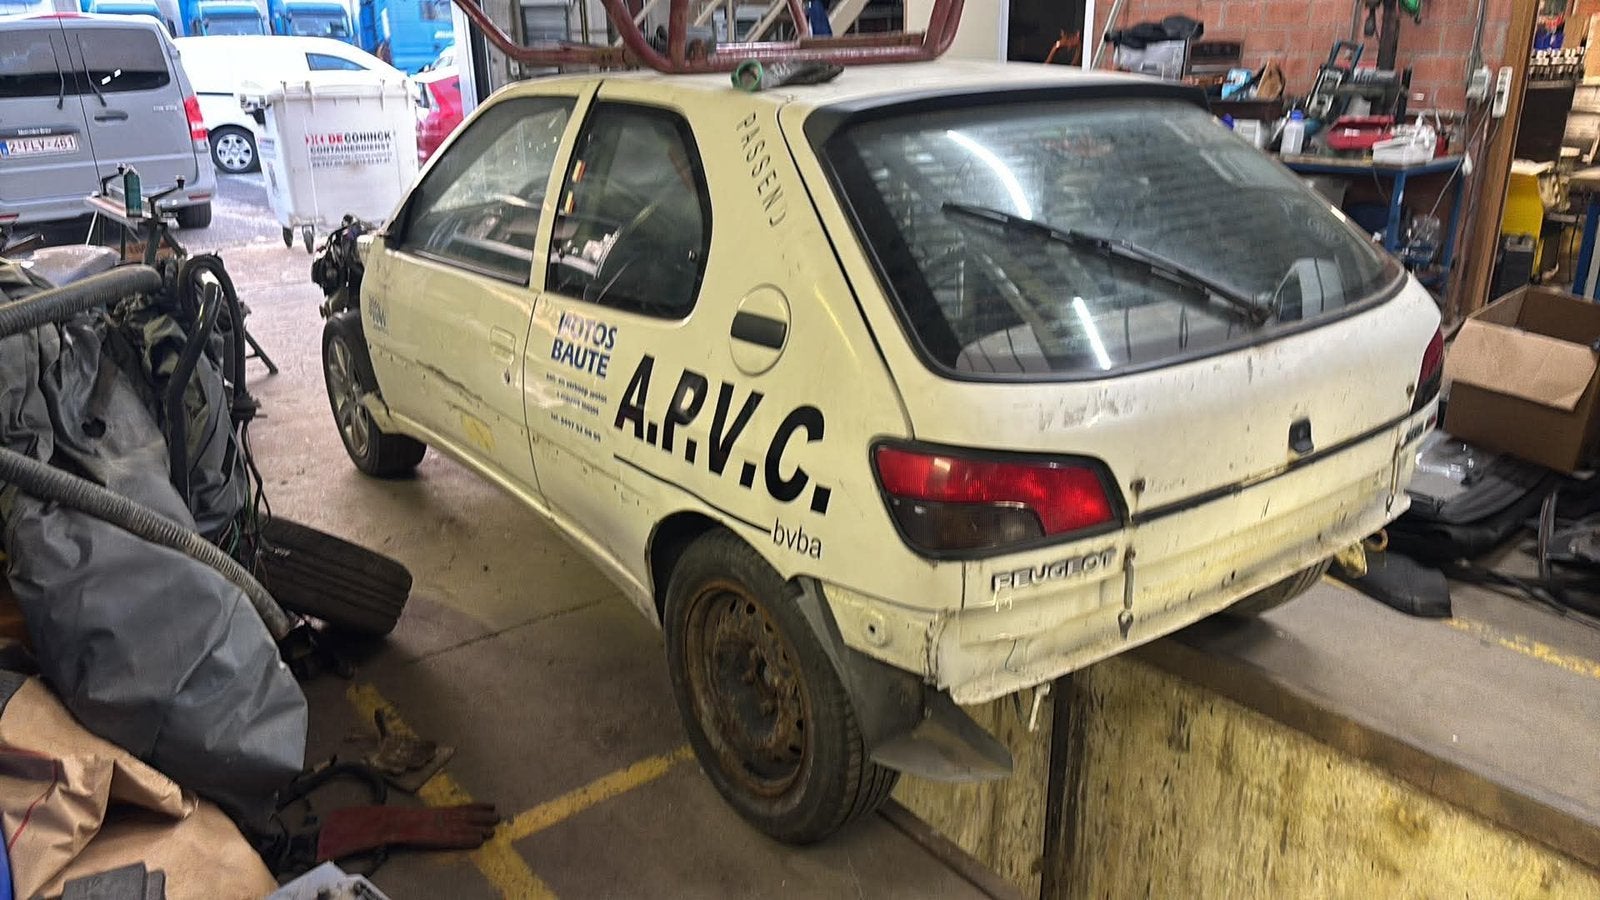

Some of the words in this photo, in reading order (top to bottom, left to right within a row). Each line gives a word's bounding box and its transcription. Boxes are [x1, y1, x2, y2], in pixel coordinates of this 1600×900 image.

[551, 336, 611, 379] BAUTE
[613, 353, 831, 516] A.P.V.C.
[772, 517, 822, 560] bvba
[991, 548, 1117, 591] PEUGEOT
